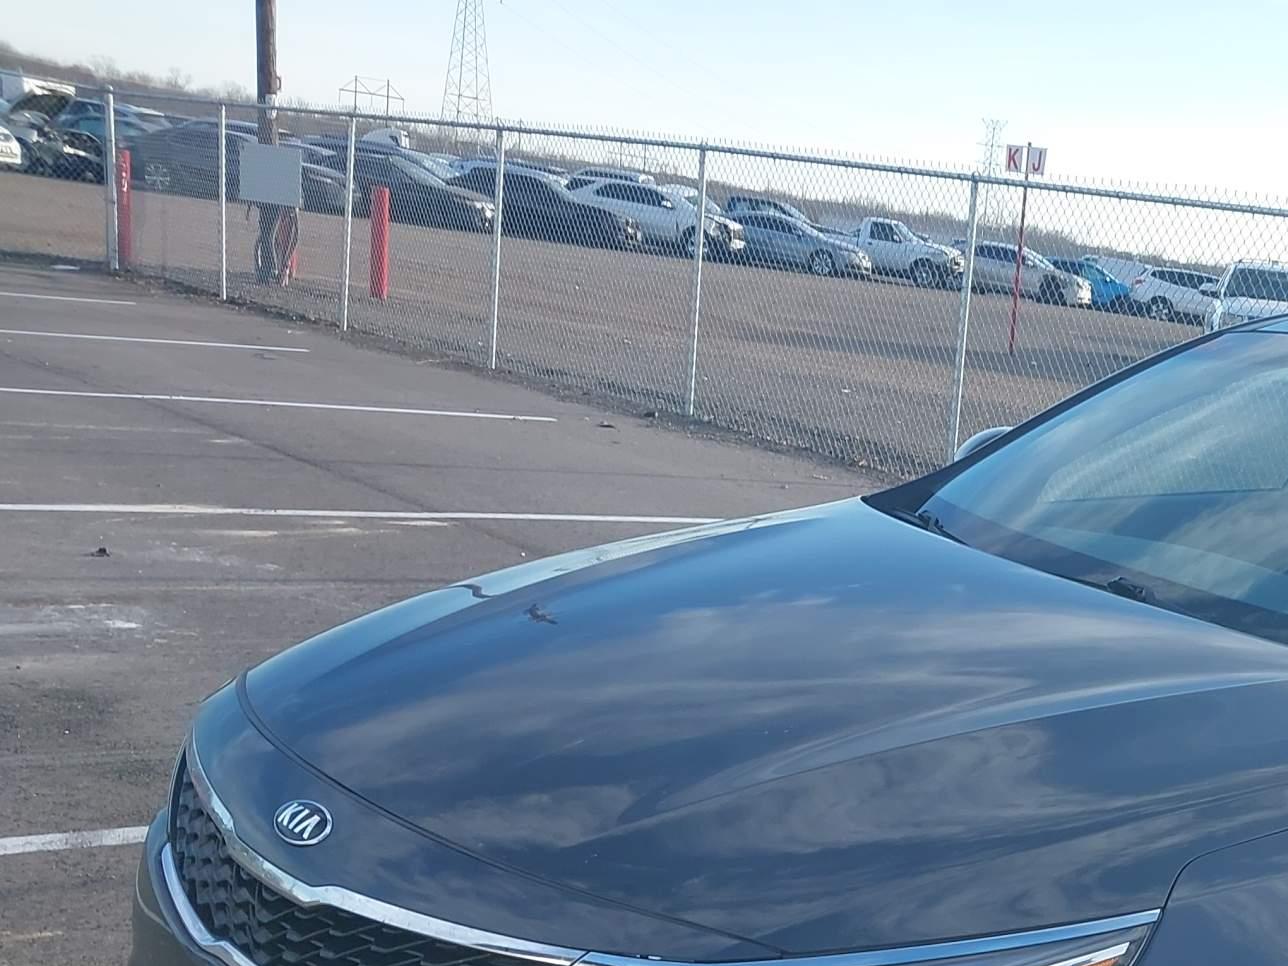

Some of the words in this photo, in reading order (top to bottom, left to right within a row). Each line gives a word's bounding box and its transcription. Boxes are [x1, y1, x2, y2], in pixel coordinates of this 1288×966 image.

[1007, 147, 1020, 170] K
[1032, 150, 1043, 172] J
[277, 802, 321, 840] KIA
